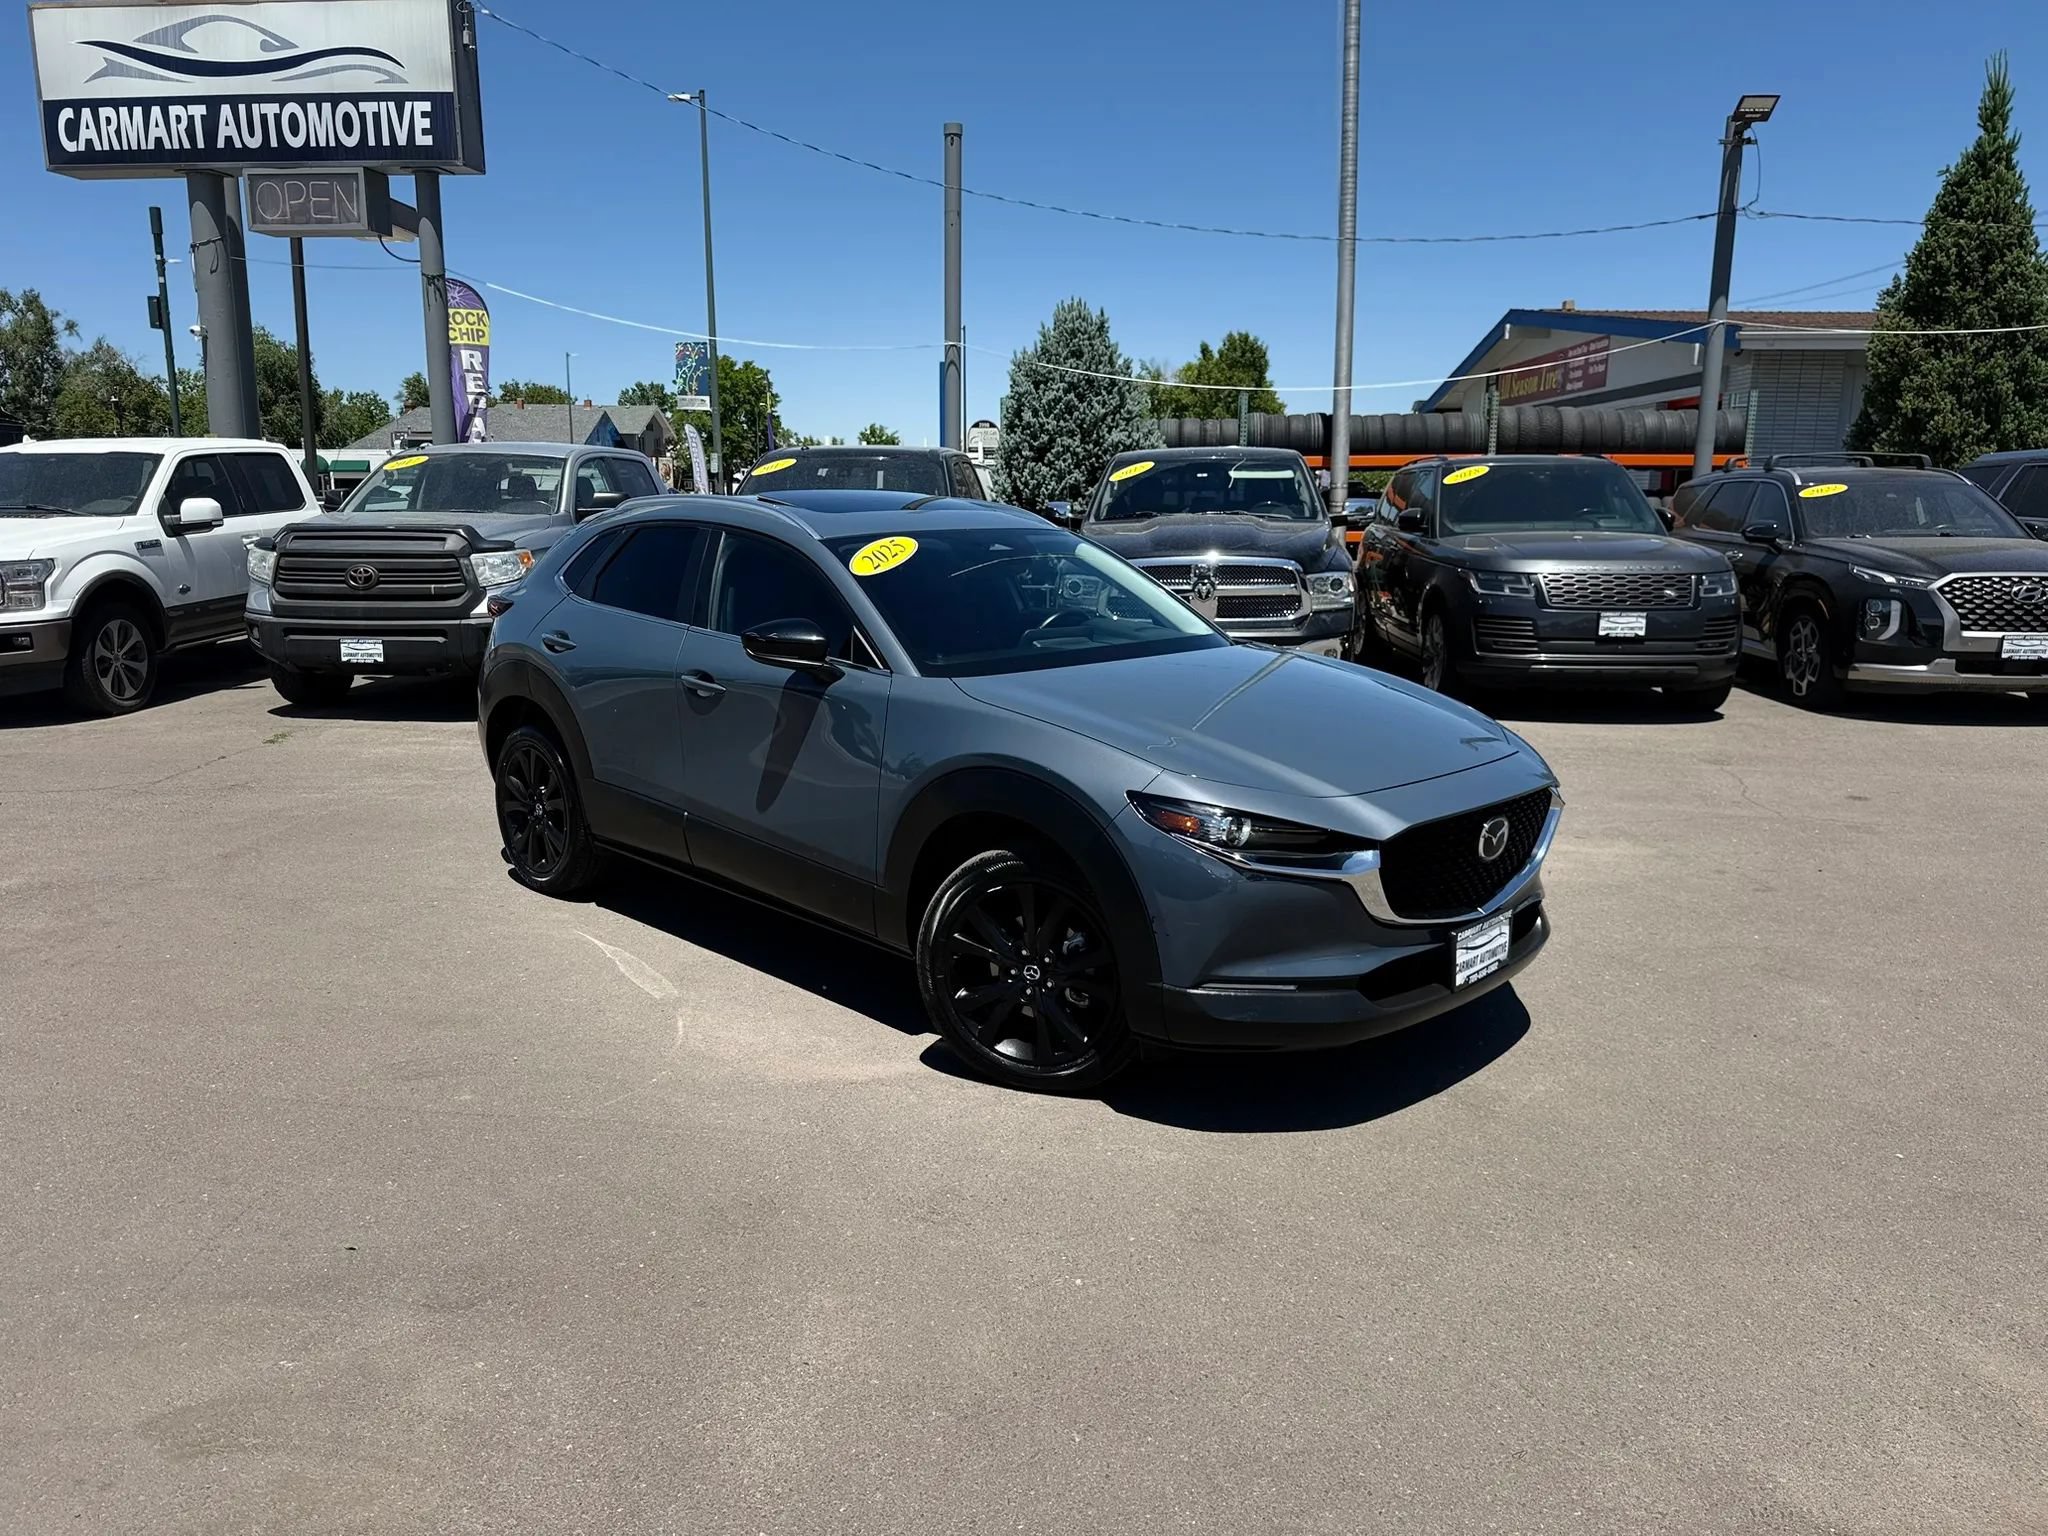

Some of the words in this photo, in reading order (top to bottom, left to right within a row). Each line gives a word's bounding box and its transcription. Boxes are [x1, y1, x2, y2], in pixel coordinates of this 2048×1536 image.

[57, 104, 207, 153] CARMART
[216, 101, 434, 149] AUTOMOTIVE
[255, 180, 358, 220] OPEN
[1511, 372, 1539, 398] Season
[861, 539, 906, 570] 2025
[1480, 941, 1508, 963] AUTOMOTIVE
